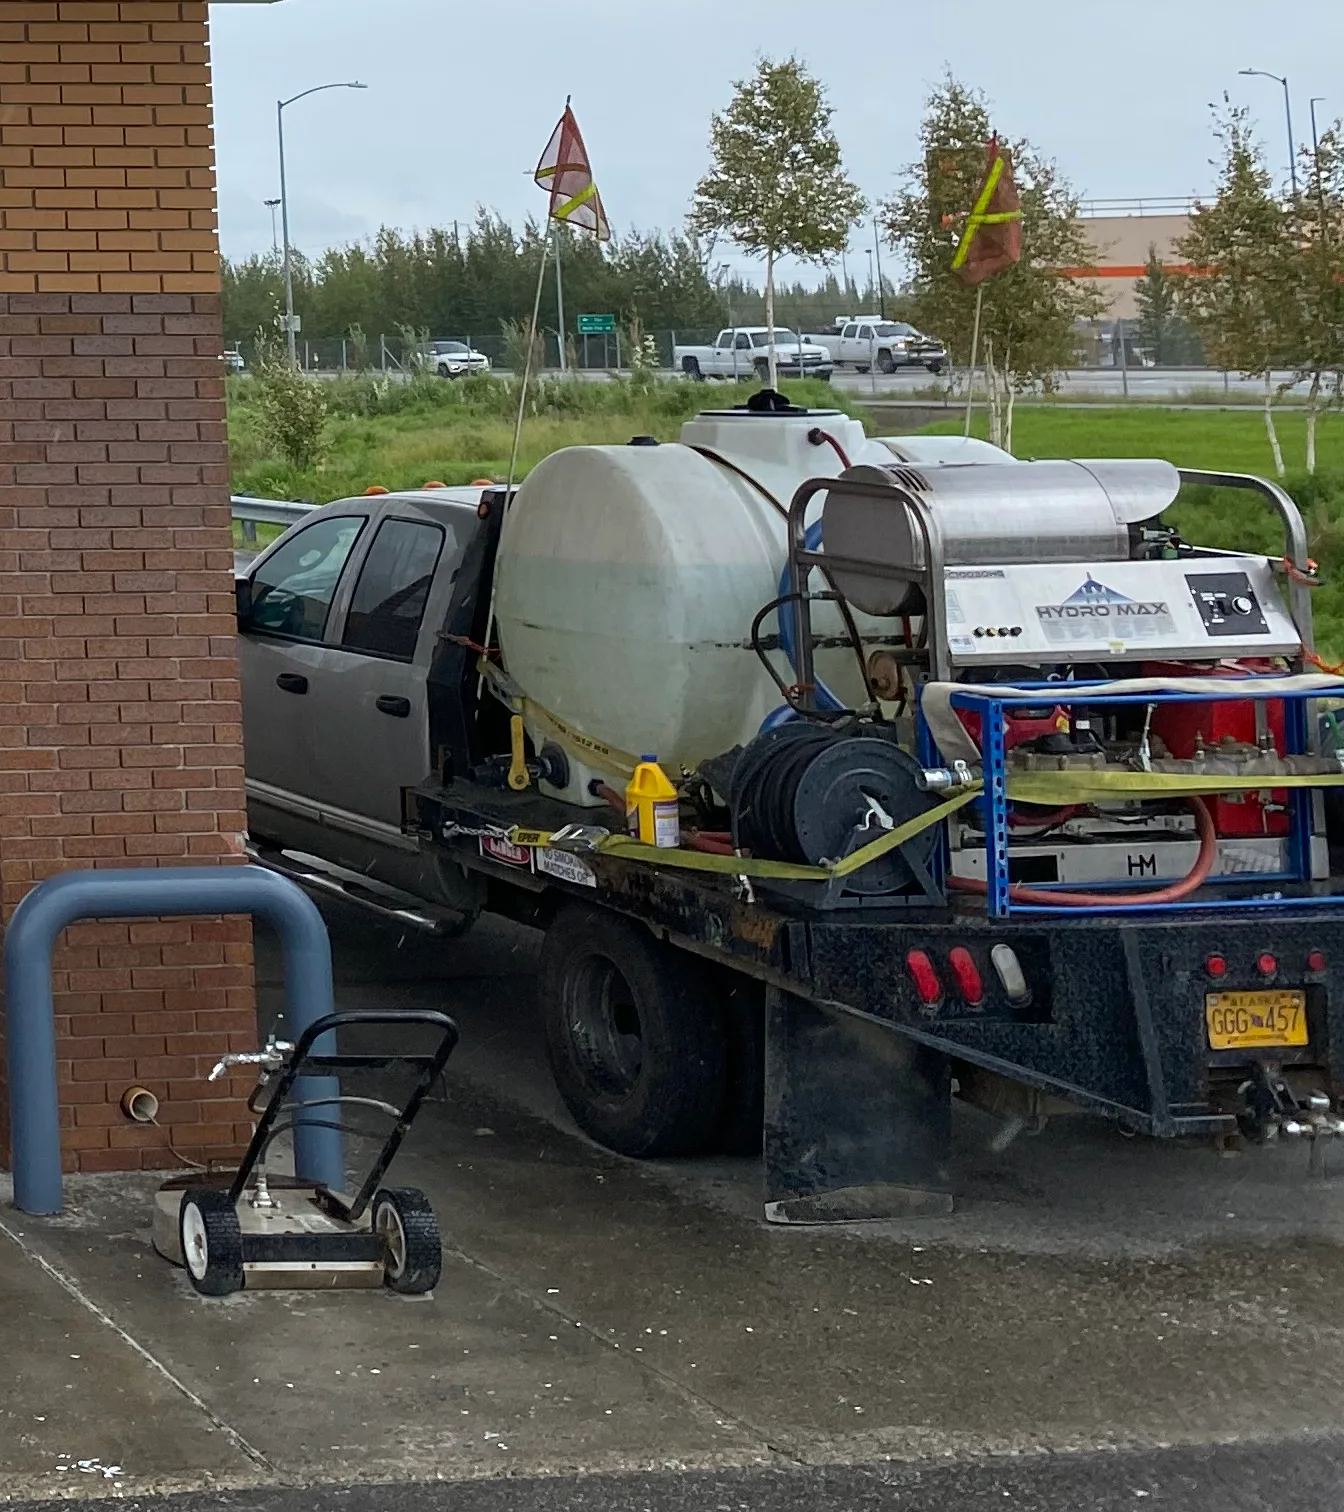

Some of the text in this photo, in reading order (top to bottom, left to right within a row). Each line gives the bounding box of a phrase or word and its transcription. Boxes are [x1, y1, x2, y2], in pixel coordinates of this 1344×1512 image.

[1035, 602, 1169, 619] HYDRO MAX
[518, 832, 541, 843] EPER
[1128, 854, 1156, 876] HM
[1212, 1005, 1300, 1035] GGG 457
